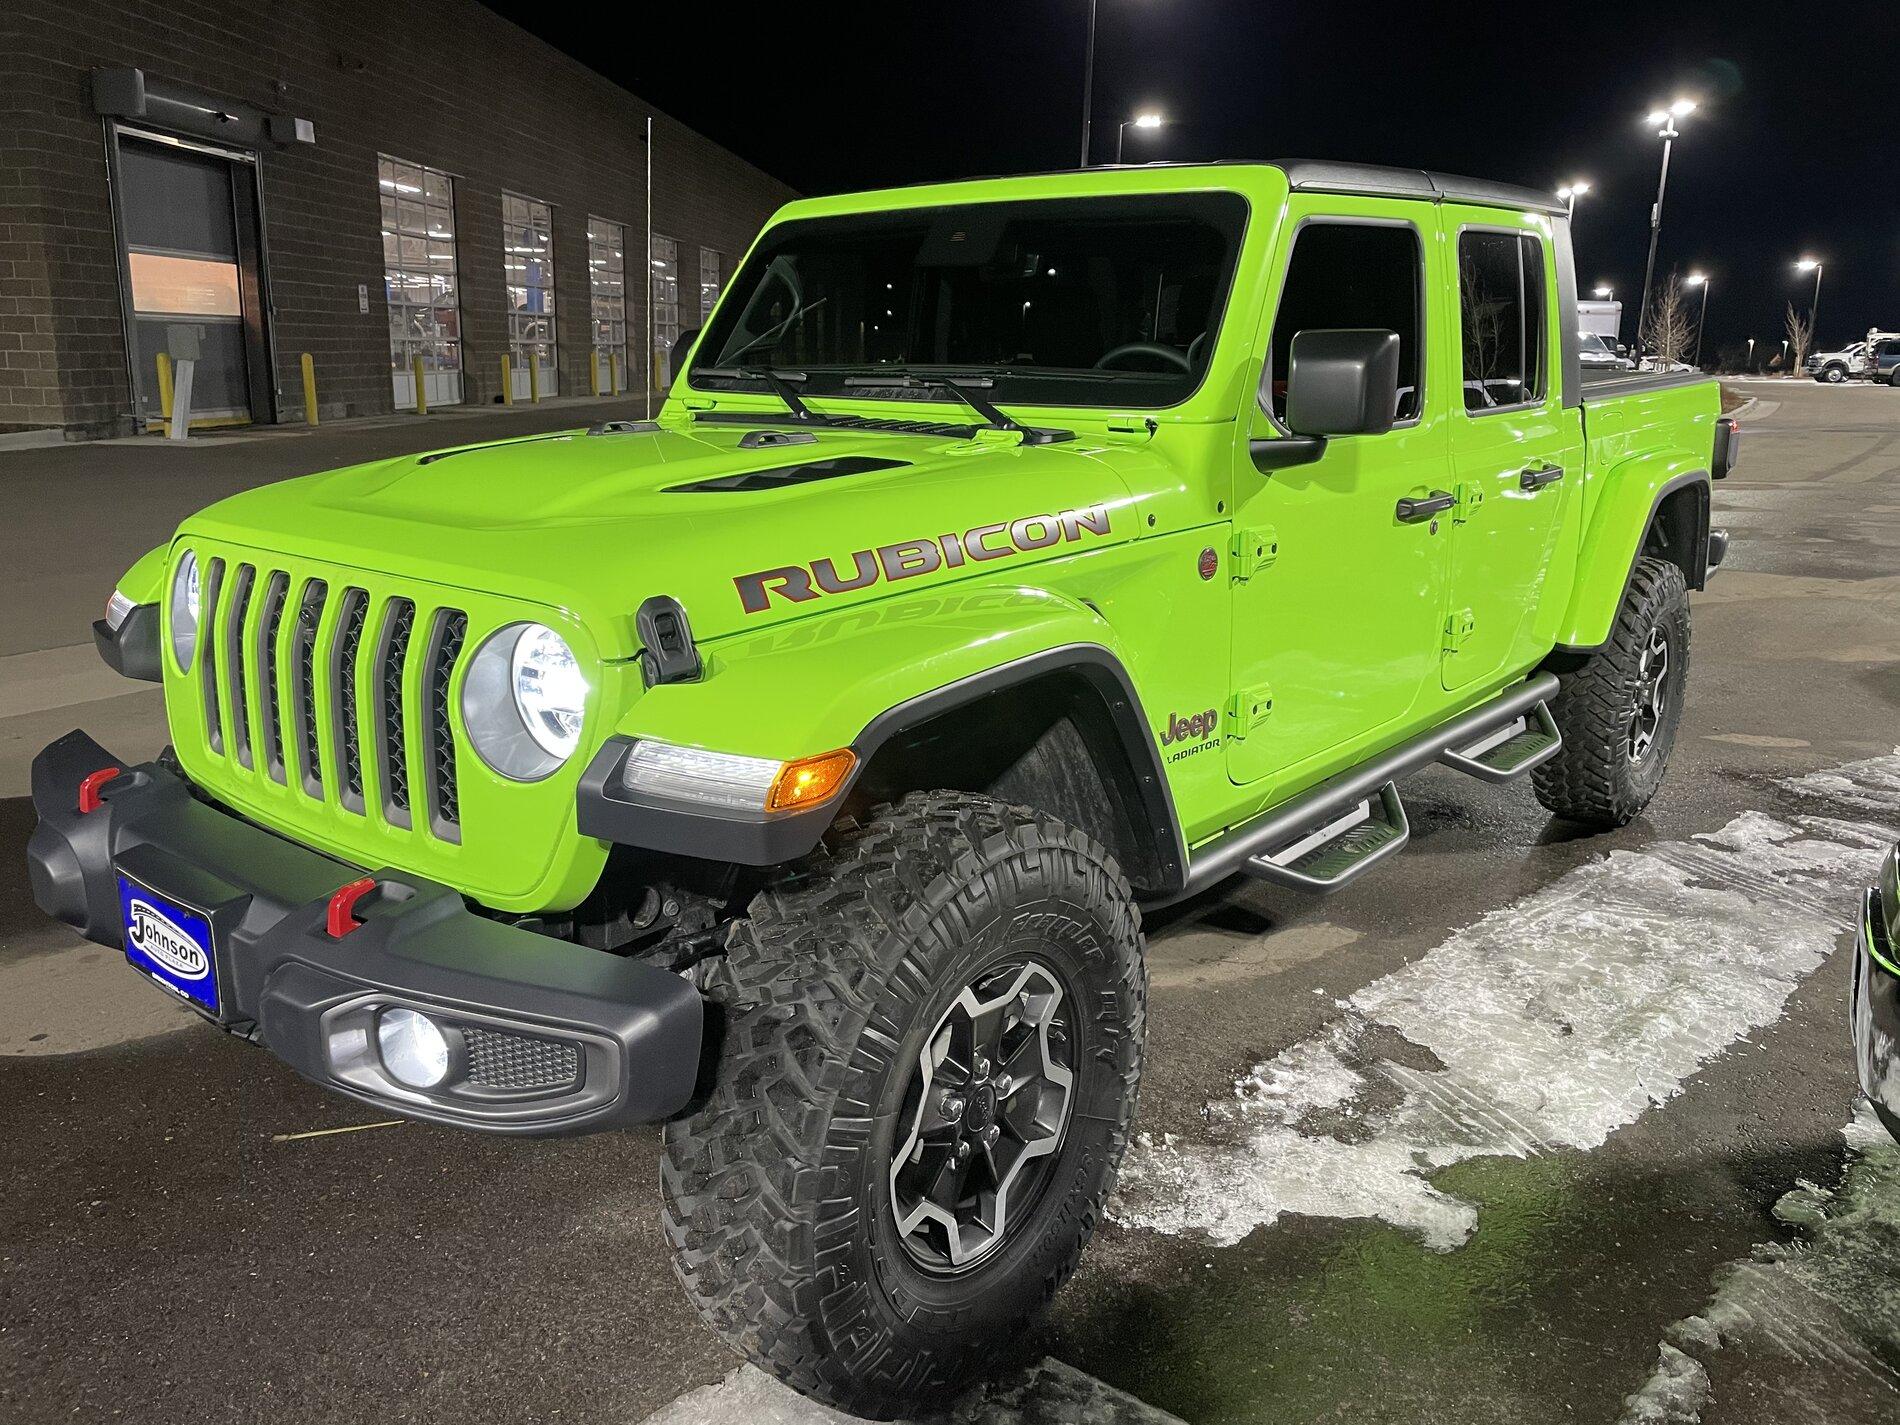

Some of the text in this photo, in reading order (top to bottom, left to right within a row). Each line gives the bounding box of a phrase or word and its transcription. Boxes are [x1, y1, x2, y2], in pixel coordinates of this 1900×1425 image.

[734, 503, 1111, 613] RUBICON
[1160, 709, 1217, 746] Jeep
[1166, 738, 1220, 763] LADIATOR
[131, 915, 199, 966] Johnson
